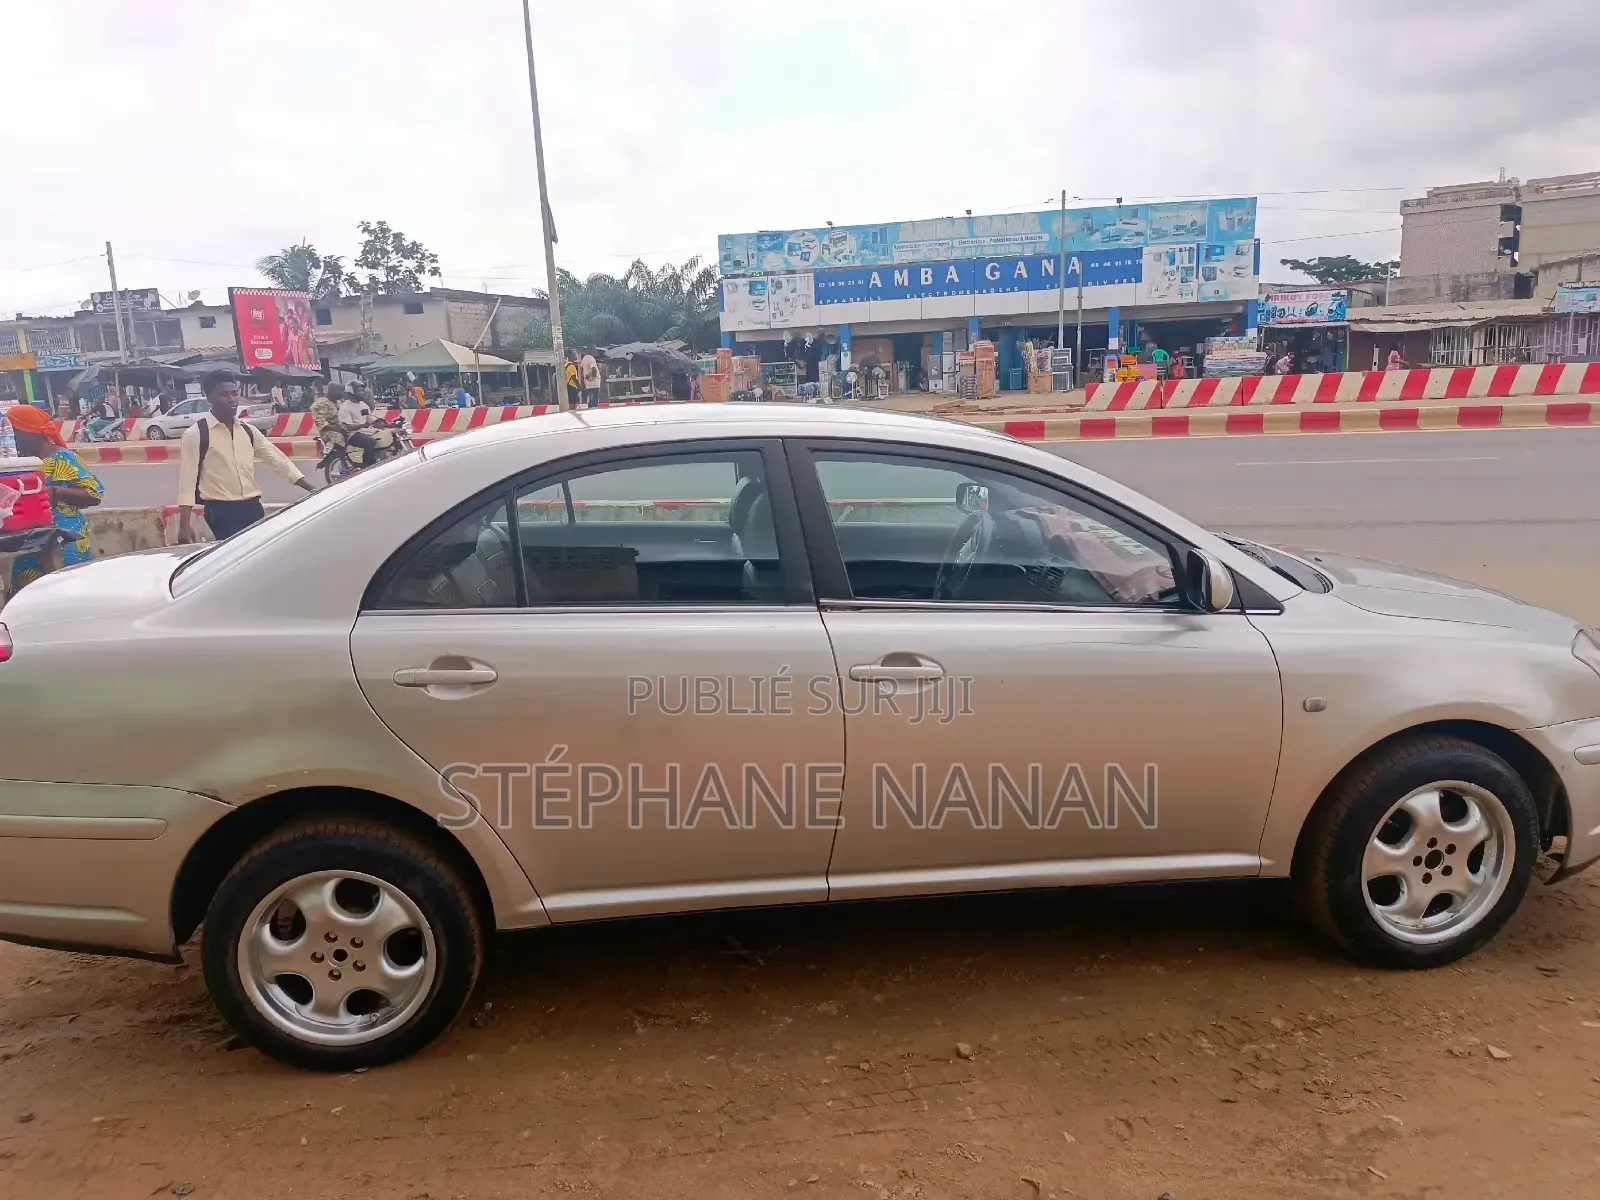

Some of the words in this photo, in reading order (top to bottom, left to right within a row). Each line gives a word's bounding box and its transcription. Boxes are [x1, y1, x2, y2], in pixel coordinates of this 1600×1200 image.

[869, 265, 959, 288] AMBA
[985, 256, 1080, 281] GANA
[819, 295, 881, 305] APPAREILS
[1087, 277, 1136, 286] DIVERS
